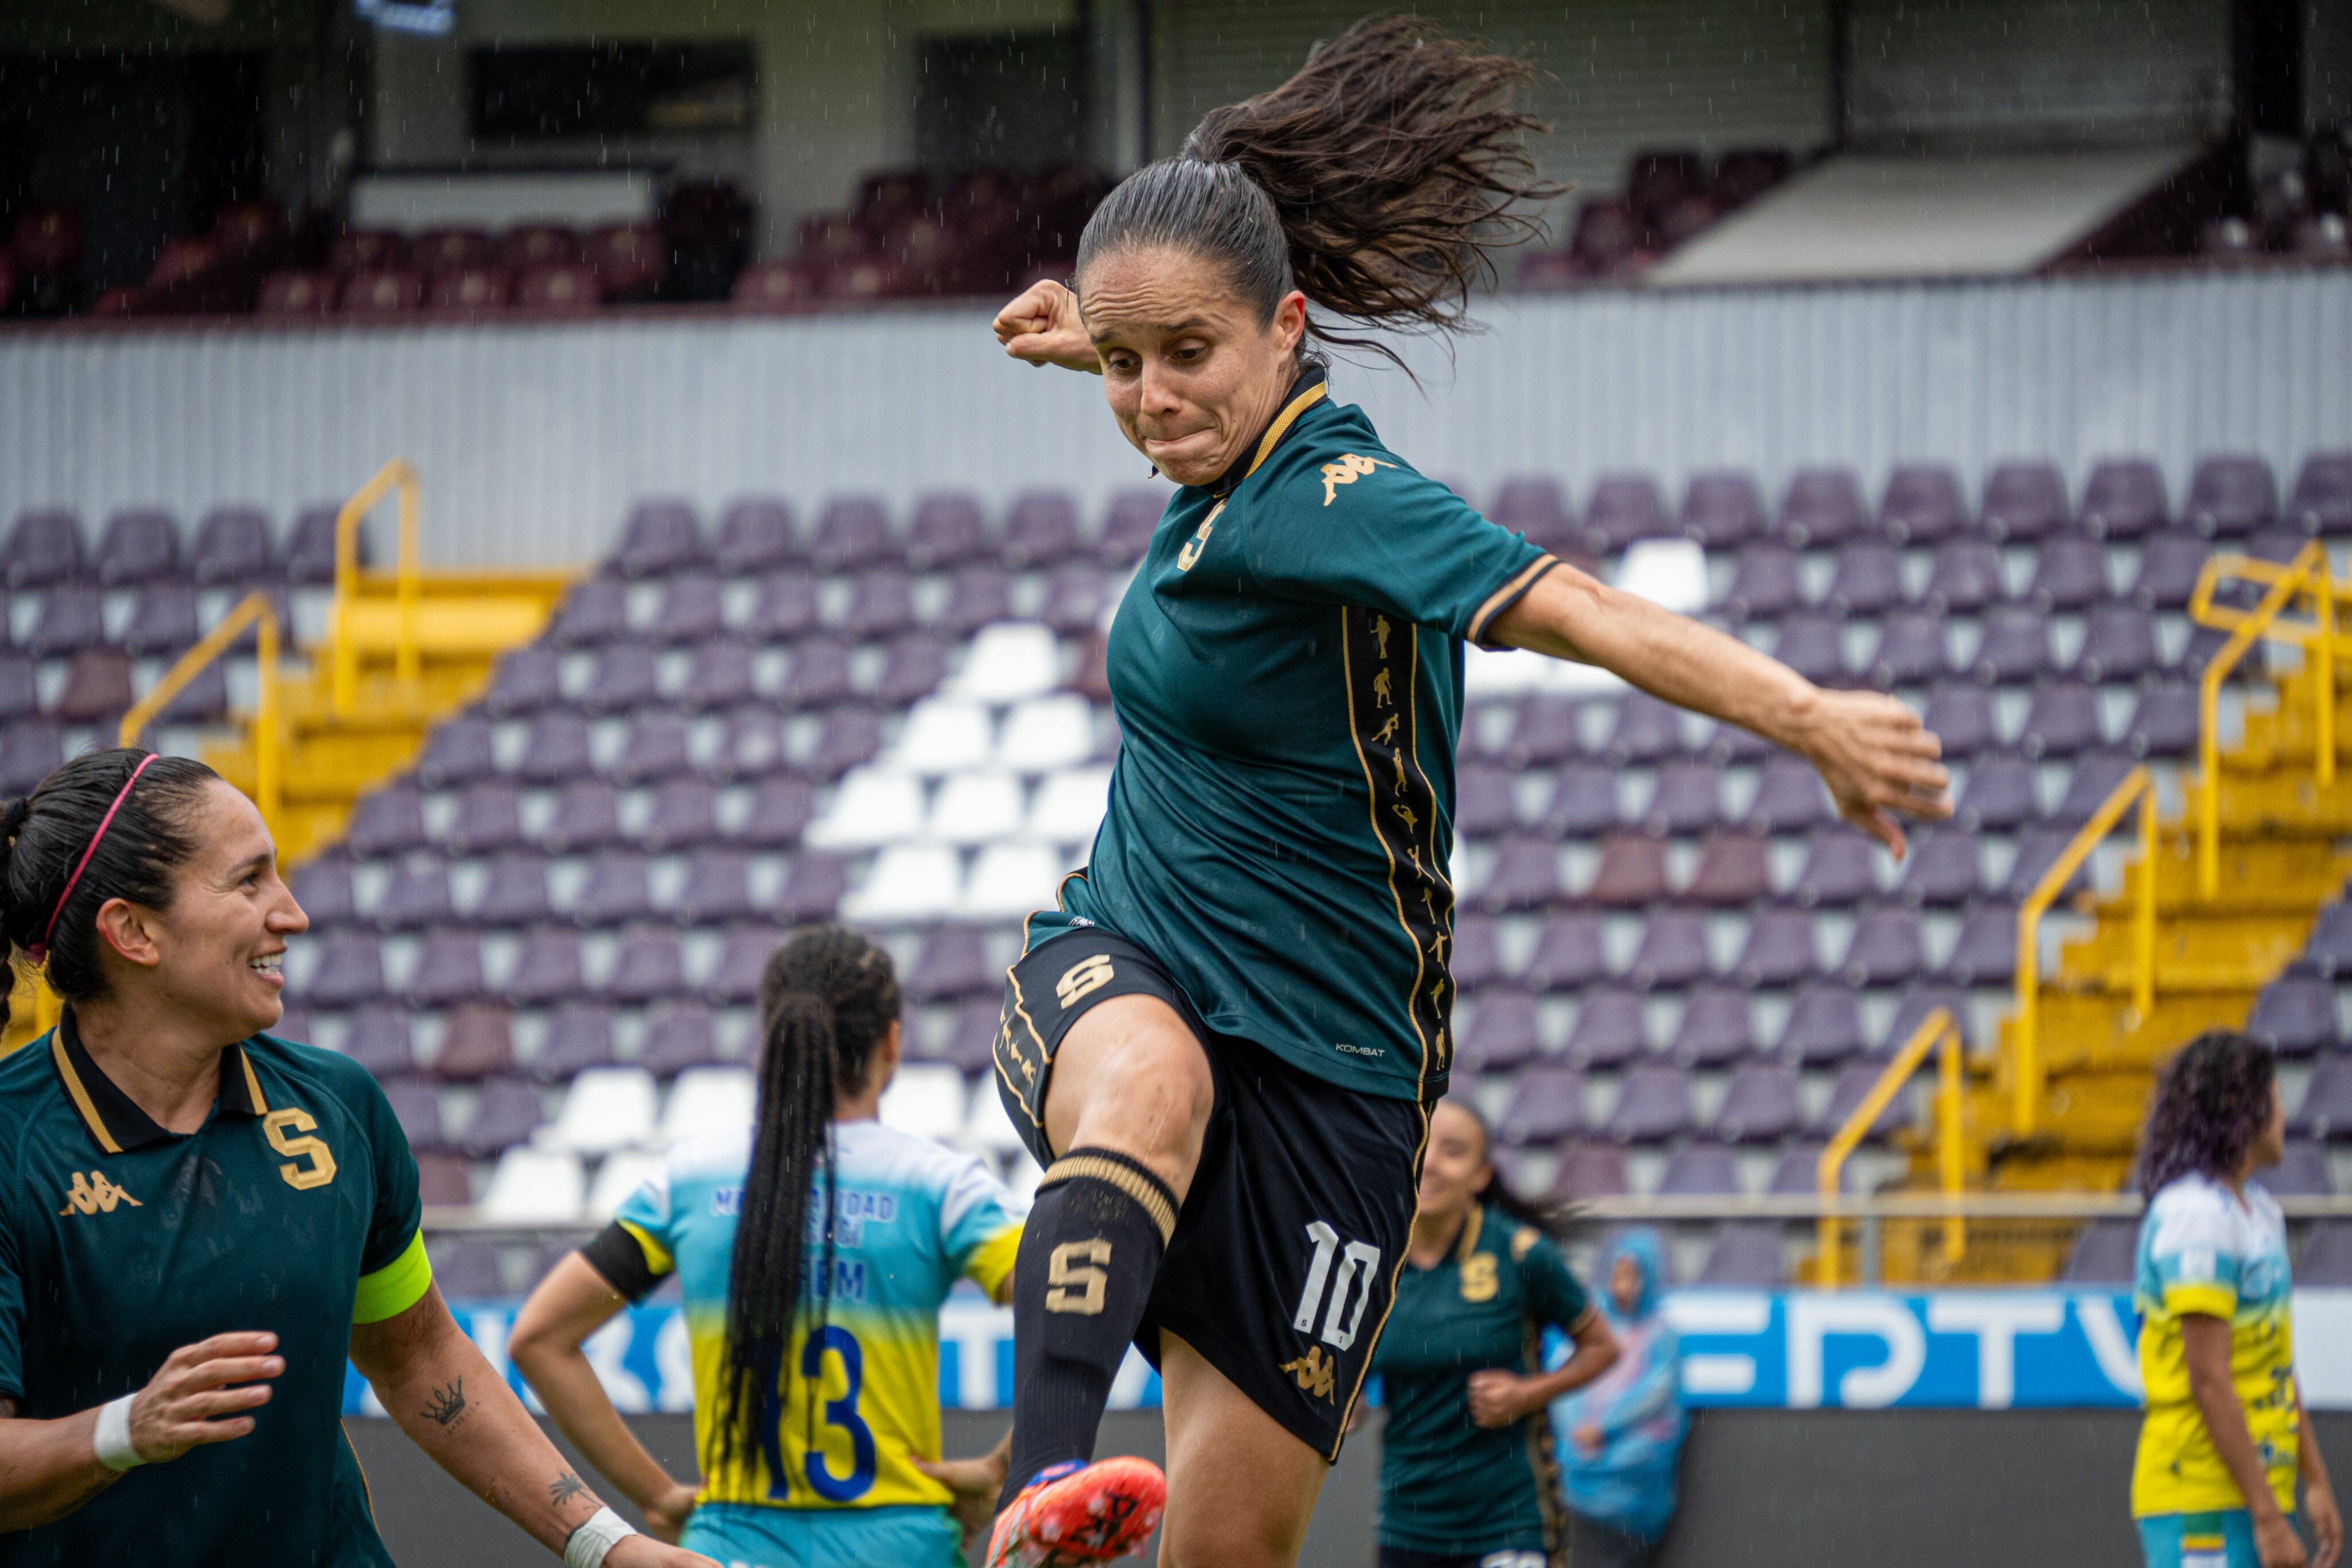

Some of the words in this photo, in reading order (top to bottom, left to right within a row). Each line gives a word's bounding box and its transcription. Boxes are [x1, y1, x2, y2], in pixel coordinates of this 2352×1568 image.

[1055, 954, 1115, 1010] S
[1335, 1043, 1385, 1057] KOMBAT
[262, 1107, 337, 1190] S
[1045, 1236, 1112, 1315] S
[1294, 1221, 1380, 1352] 10
